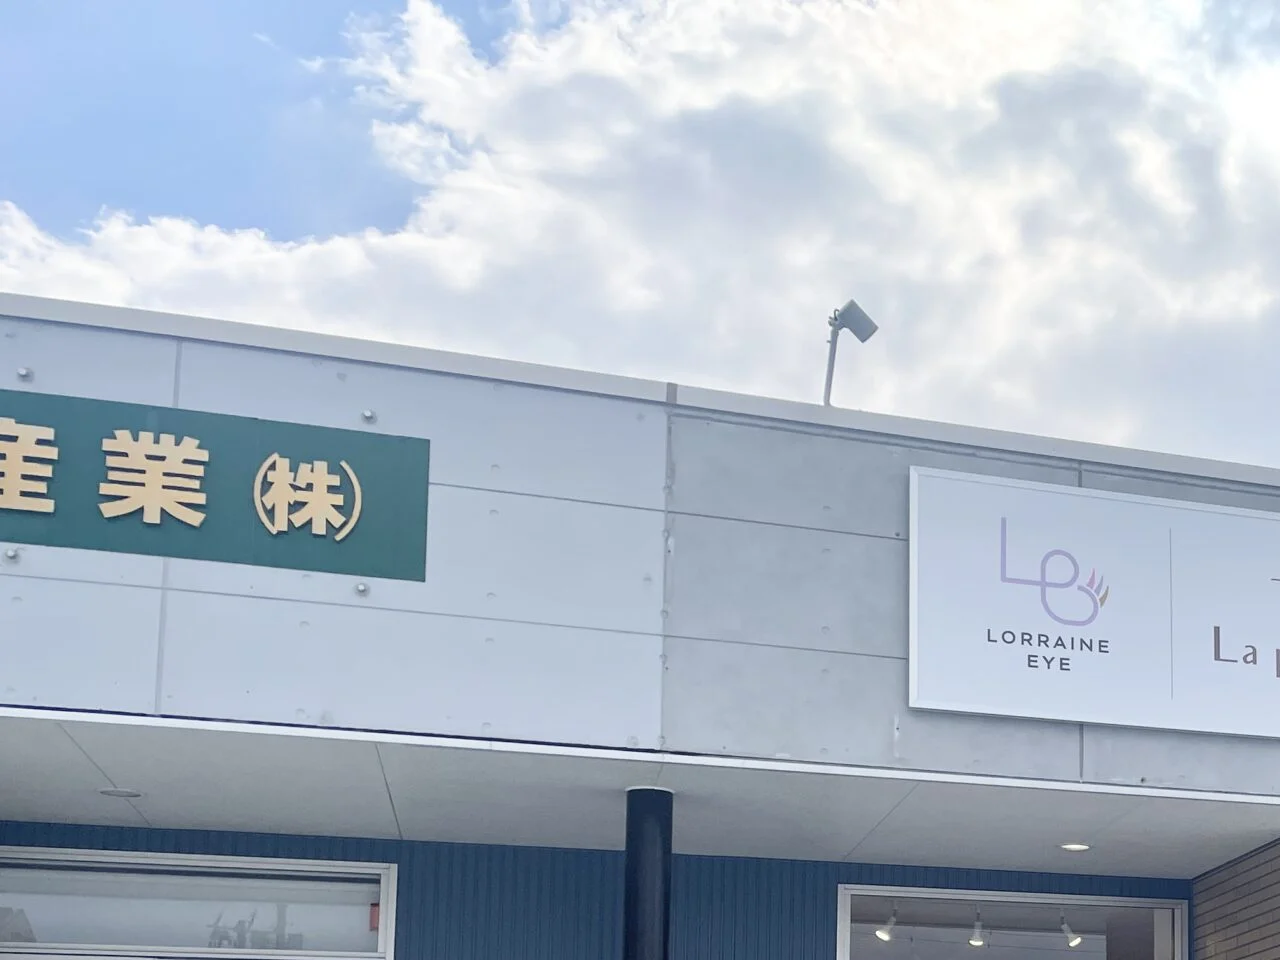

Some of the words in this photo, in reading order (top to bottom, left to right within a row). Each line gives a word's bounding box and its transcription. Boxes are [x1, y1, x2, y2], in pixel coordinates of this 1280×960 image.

[986, 628, 1111, 654] LORRAINE
[1213, 626, 1258, 666] La
[1026, 653, 1072, 672] EYE
